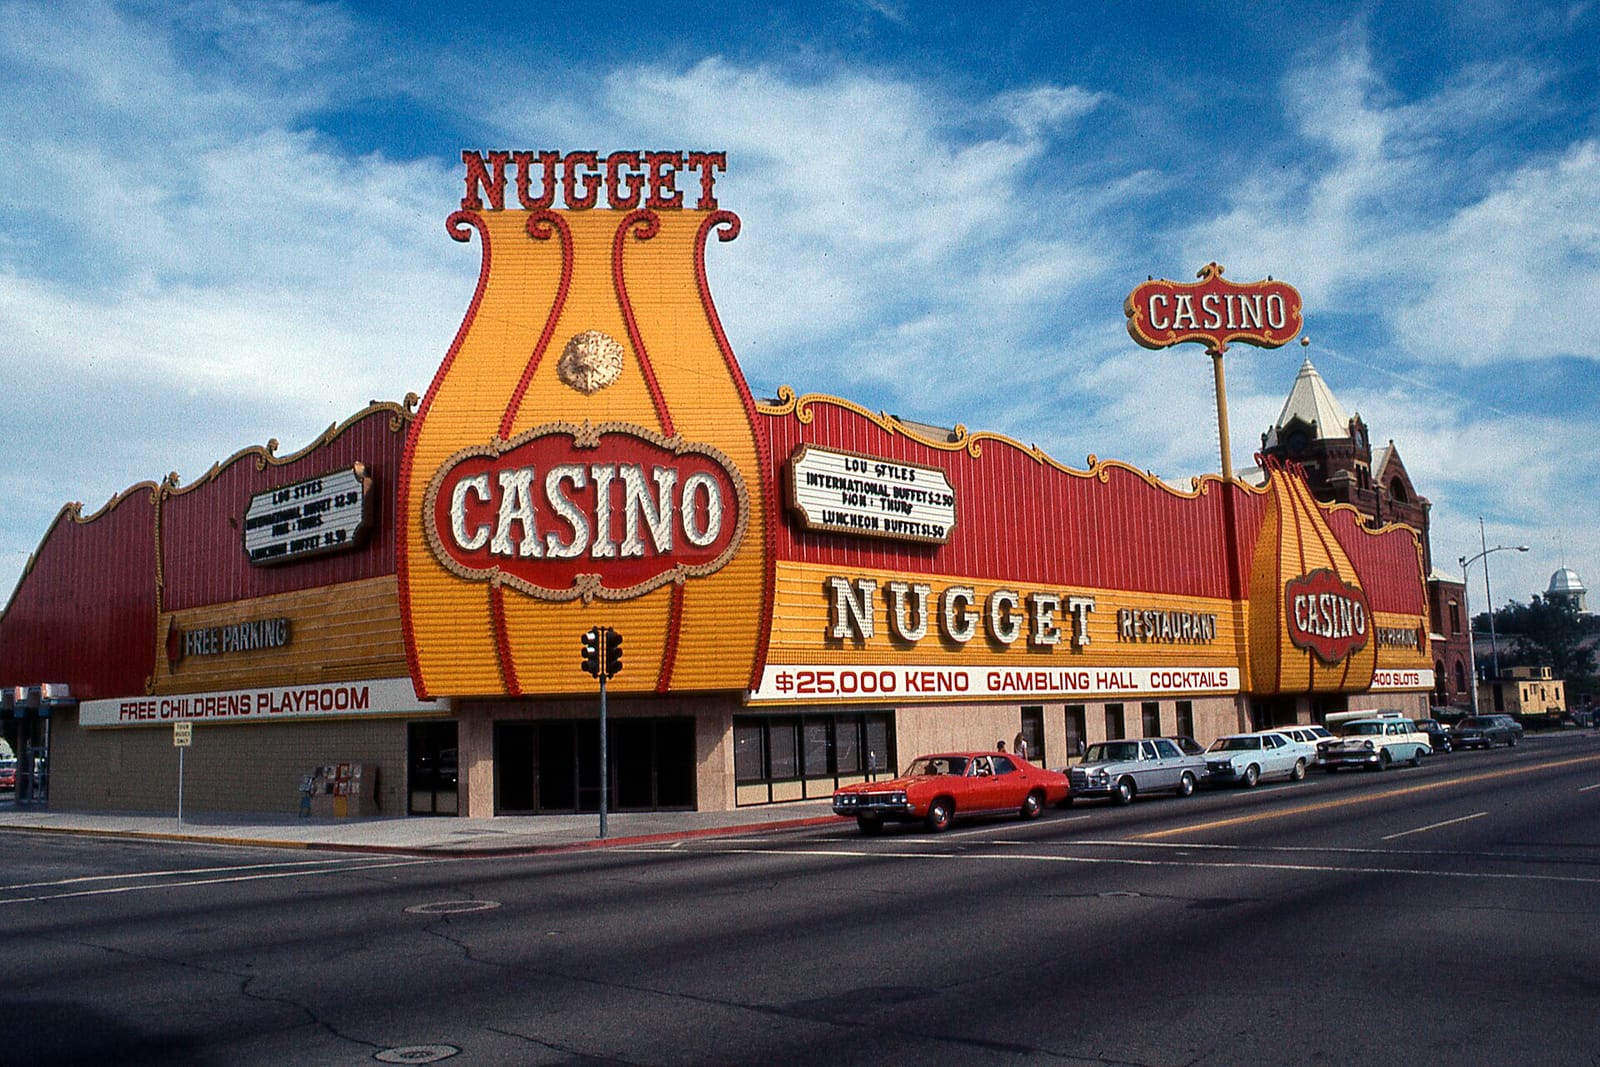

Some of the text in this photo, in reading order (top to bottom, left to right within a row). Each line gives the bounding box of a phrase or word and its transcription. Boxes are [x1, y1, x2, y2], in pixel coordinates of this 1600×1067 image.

[461, 150, 727, 210] NUGGET
[1148, 293, 1287, 330] CASINO
[806, 471, 891, 497] INTERNATIONAL
[845, 458, 916, 482] LOU STYLES
[450, 463, 722, 558] CASINO
[822, 509, 879, 529] LUNCHEON
[883, 519, 921, 536] BUFFET
[829, 575, 1218, 645] NUGGET RESTAURANT
[1295, 593, 1365, 639] CASINO
[185, 617, 288, 656] FREE PARKING
[775, 670, 1229, 695] $25,000 KENO GAMBLING HALL COCKTAILS
[1393, 673, 1419, 685] SLOTS
[120, 687, 369, 720] FREE CHILDRENS PLAYROOM
